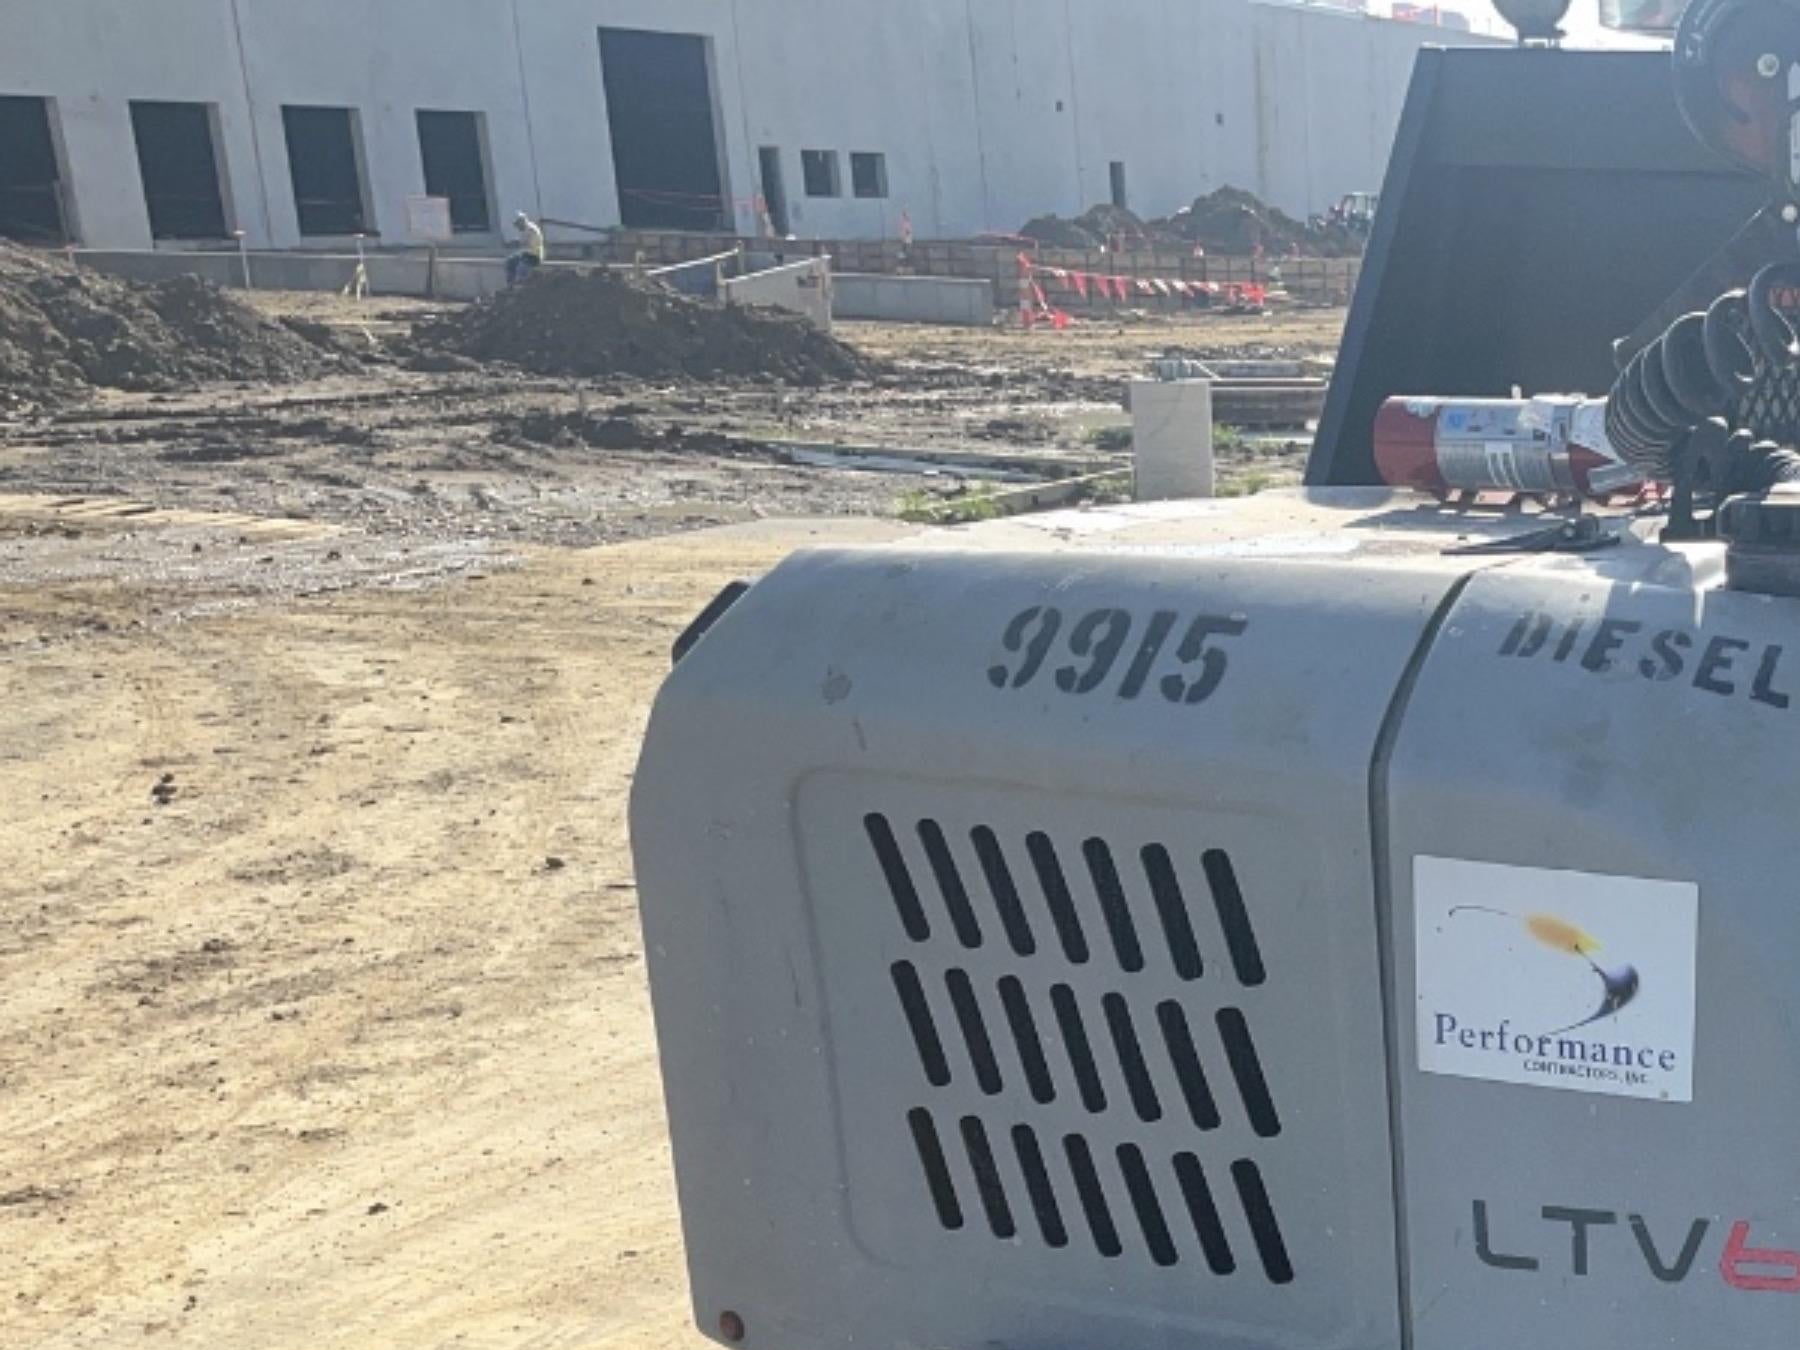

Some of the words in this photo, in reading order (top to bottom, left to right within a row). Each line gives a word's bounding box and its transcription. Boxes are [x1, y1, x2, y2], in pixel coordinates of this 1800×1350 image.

[986, 604, 1248, 705] 9915
[1497, 609, 1791, 709] DIESEL
[1433, 1012, 1677, 1072] Performance
